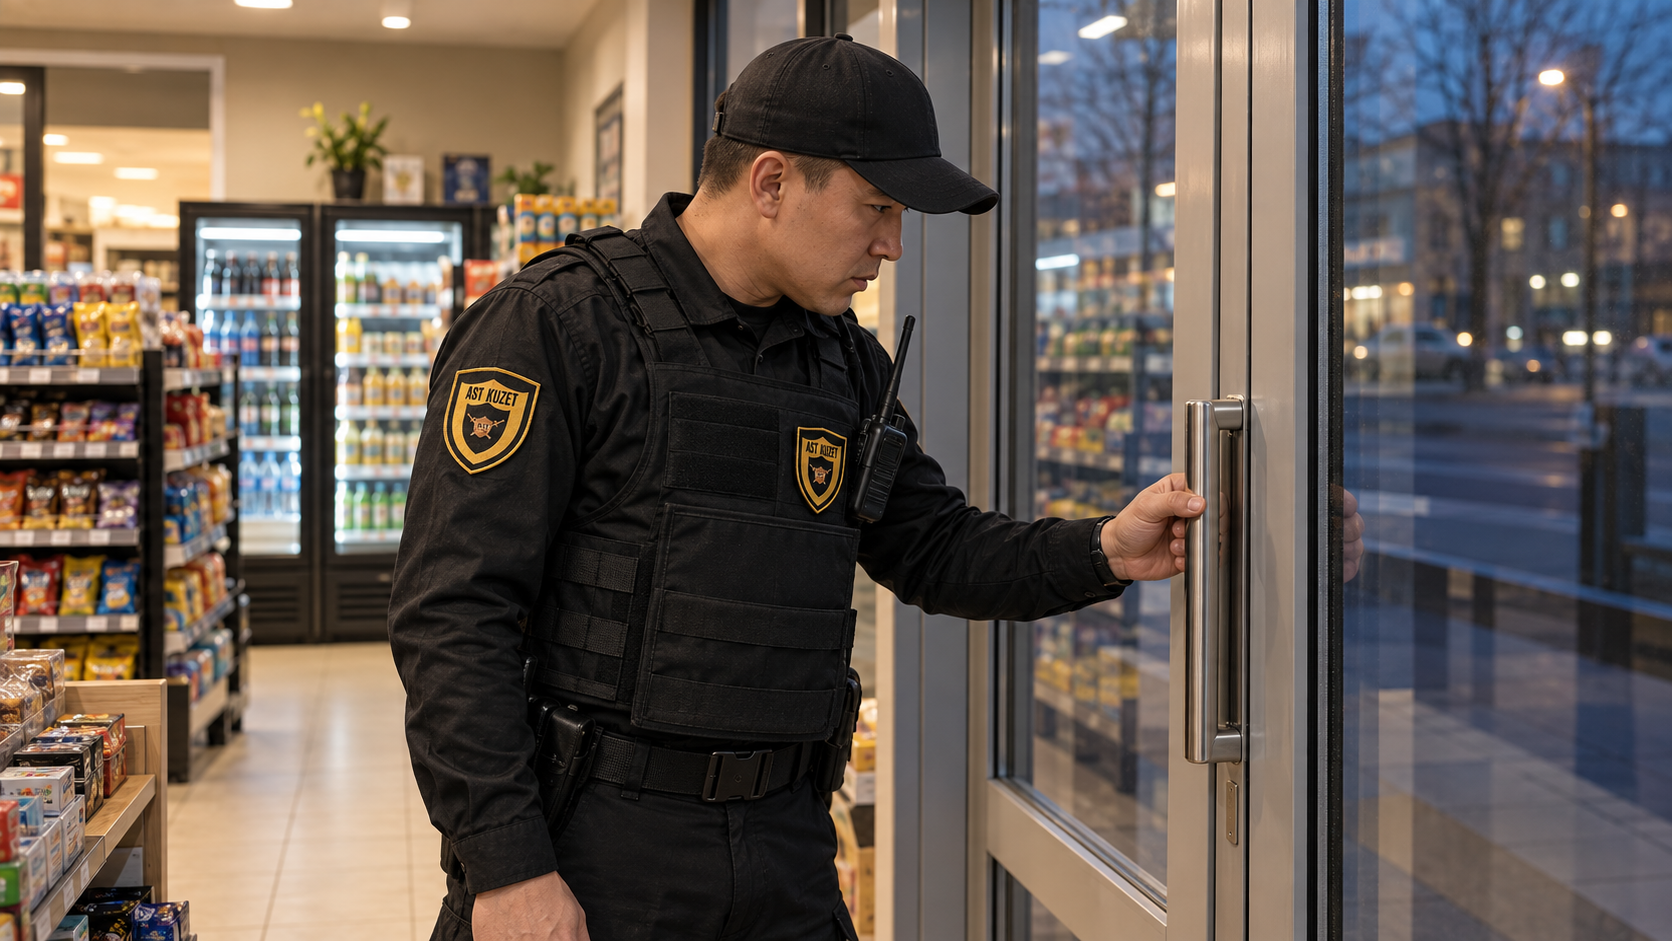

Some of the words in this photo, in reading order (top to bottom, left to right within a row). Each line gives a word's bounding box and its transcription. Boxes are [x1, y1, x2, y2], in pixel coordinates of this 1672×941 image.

[465, 386, 485, 401] AST
[485, 388, 519, 407] KUZET
[806, 441, 818, 454] AST
